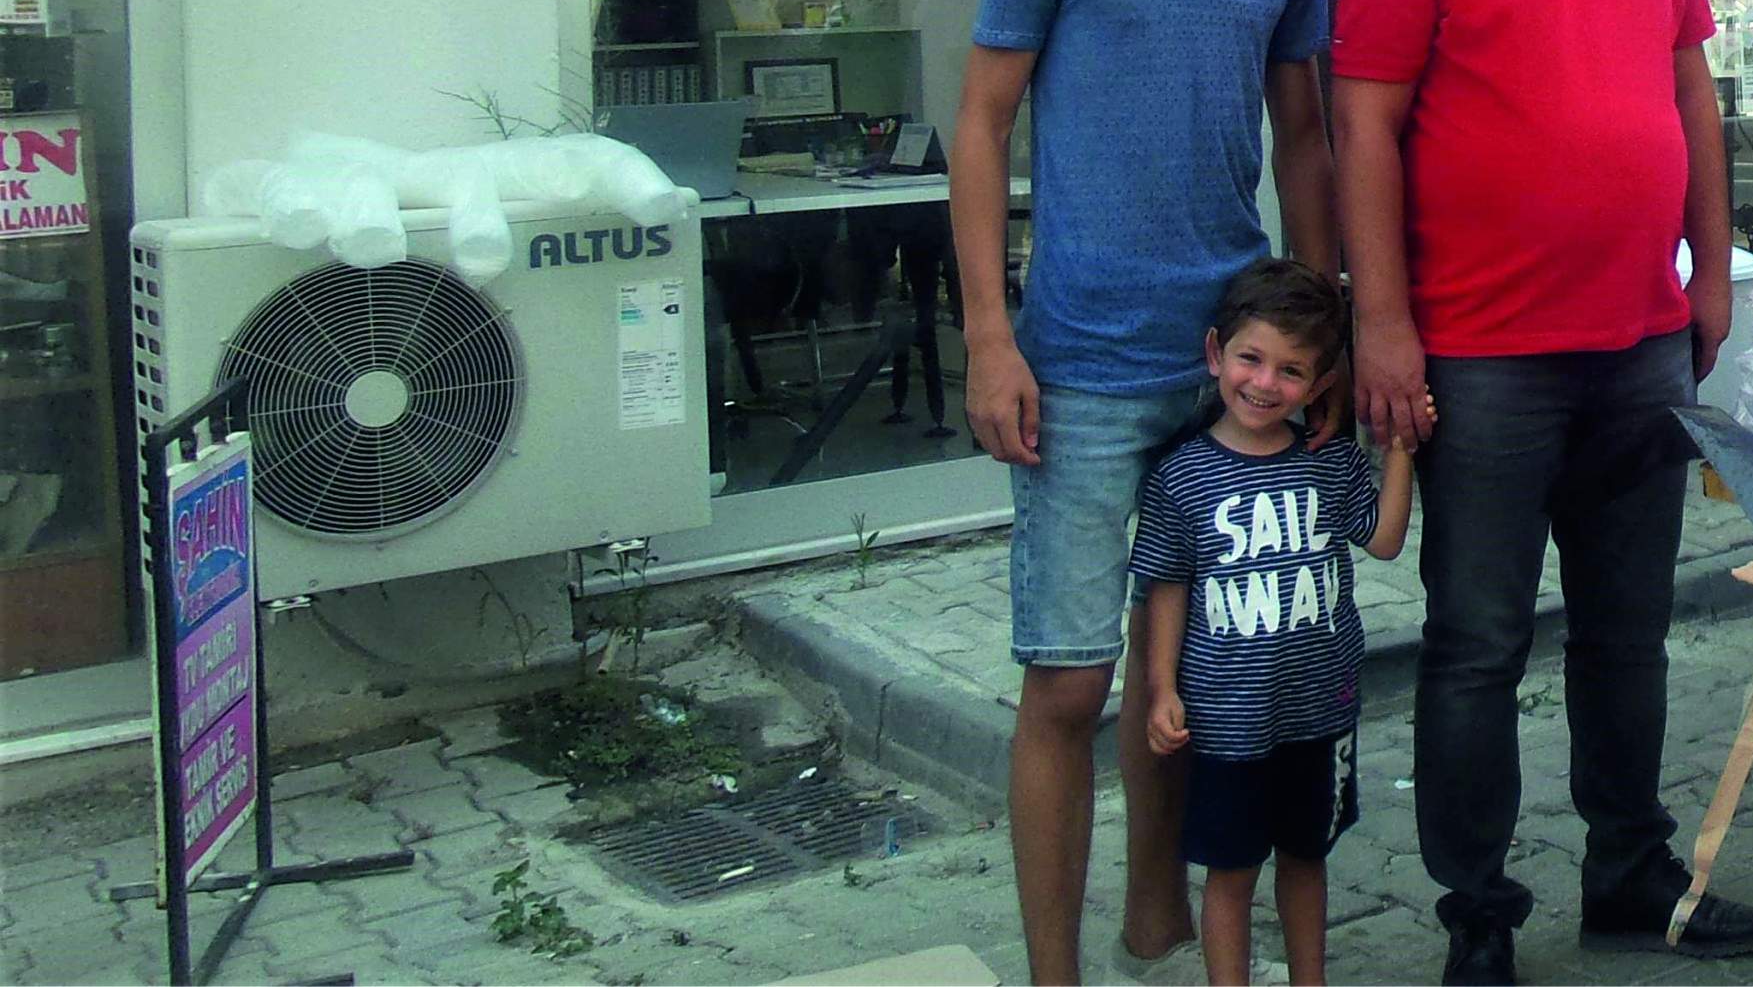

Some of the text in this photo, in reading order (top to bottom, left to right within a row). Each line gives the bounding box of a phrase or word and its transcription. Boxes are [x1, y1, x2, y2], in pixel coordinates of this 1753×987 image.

[0, 203, 88, 231] LAMAN
[529, 223, 673, 269] ALTUS
[1214, 487, 1332, 564] SAIL
[1204, 556, 1340, 637] AWAY
